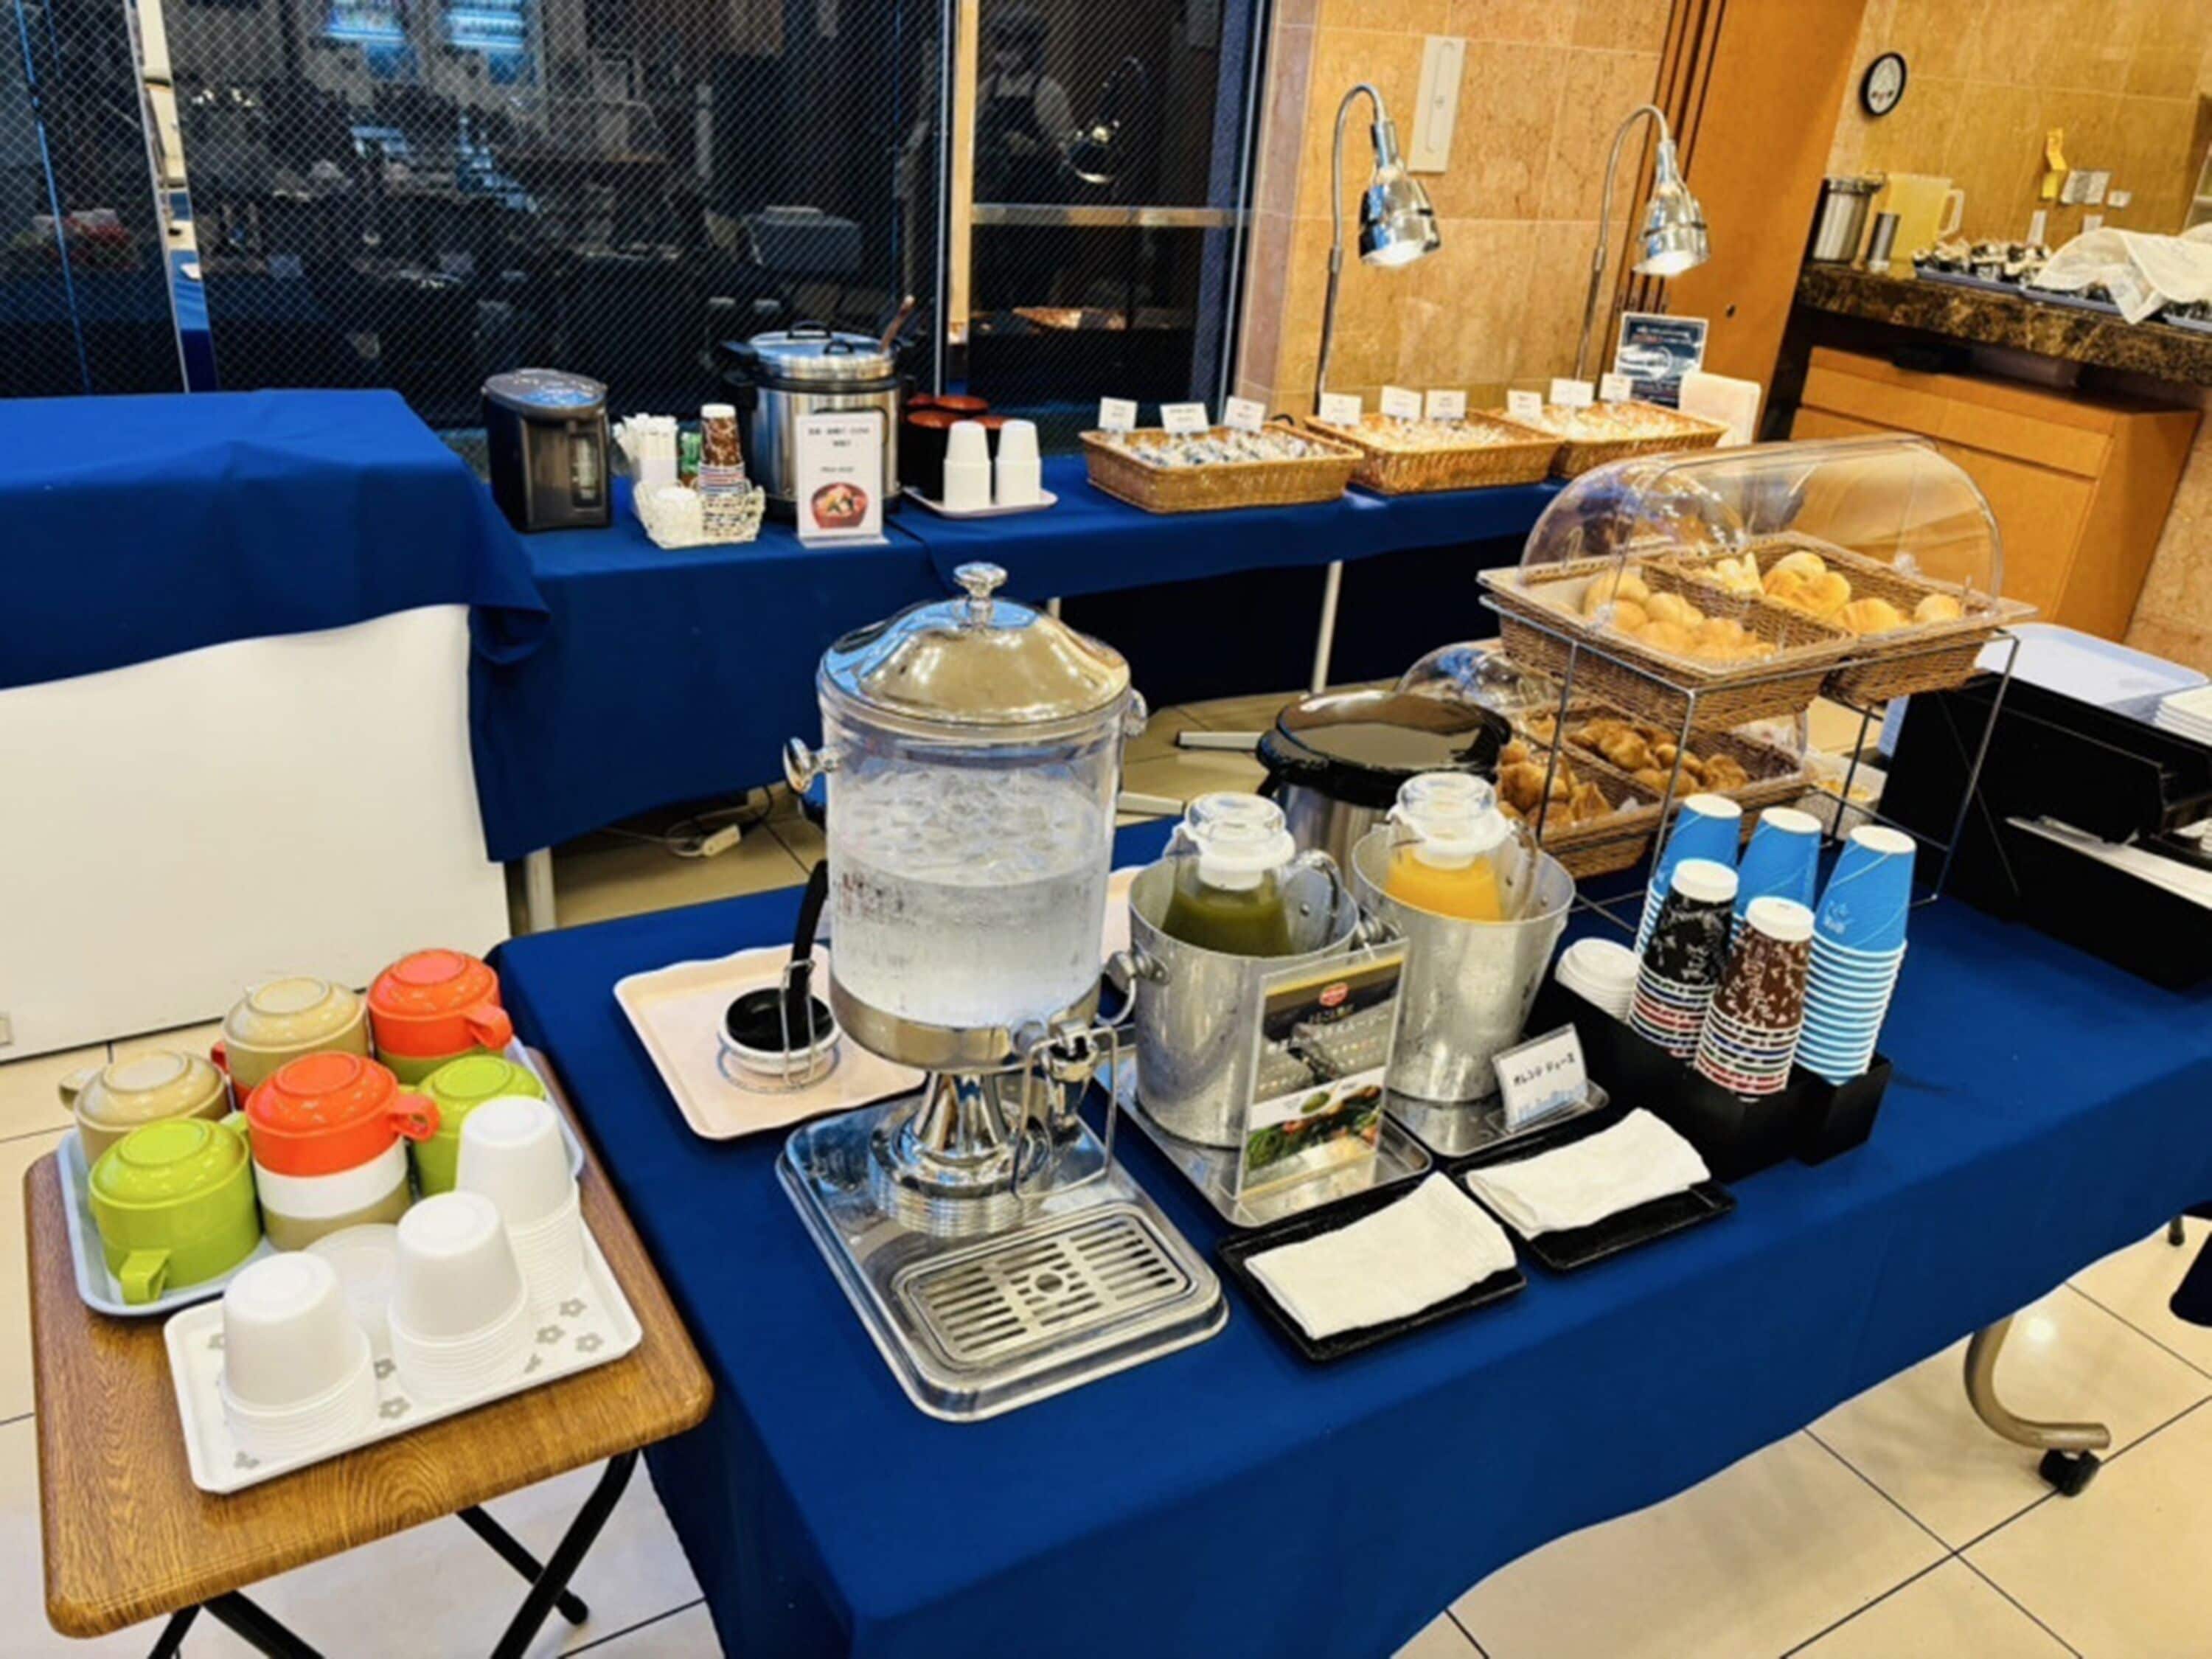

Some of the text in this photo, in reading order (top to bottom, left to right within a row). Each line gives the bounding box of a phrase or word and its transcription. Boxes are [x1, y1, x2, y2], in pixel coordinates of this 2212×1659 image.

[1514, 1051, 1575, 1085] オレンジ ジュース
